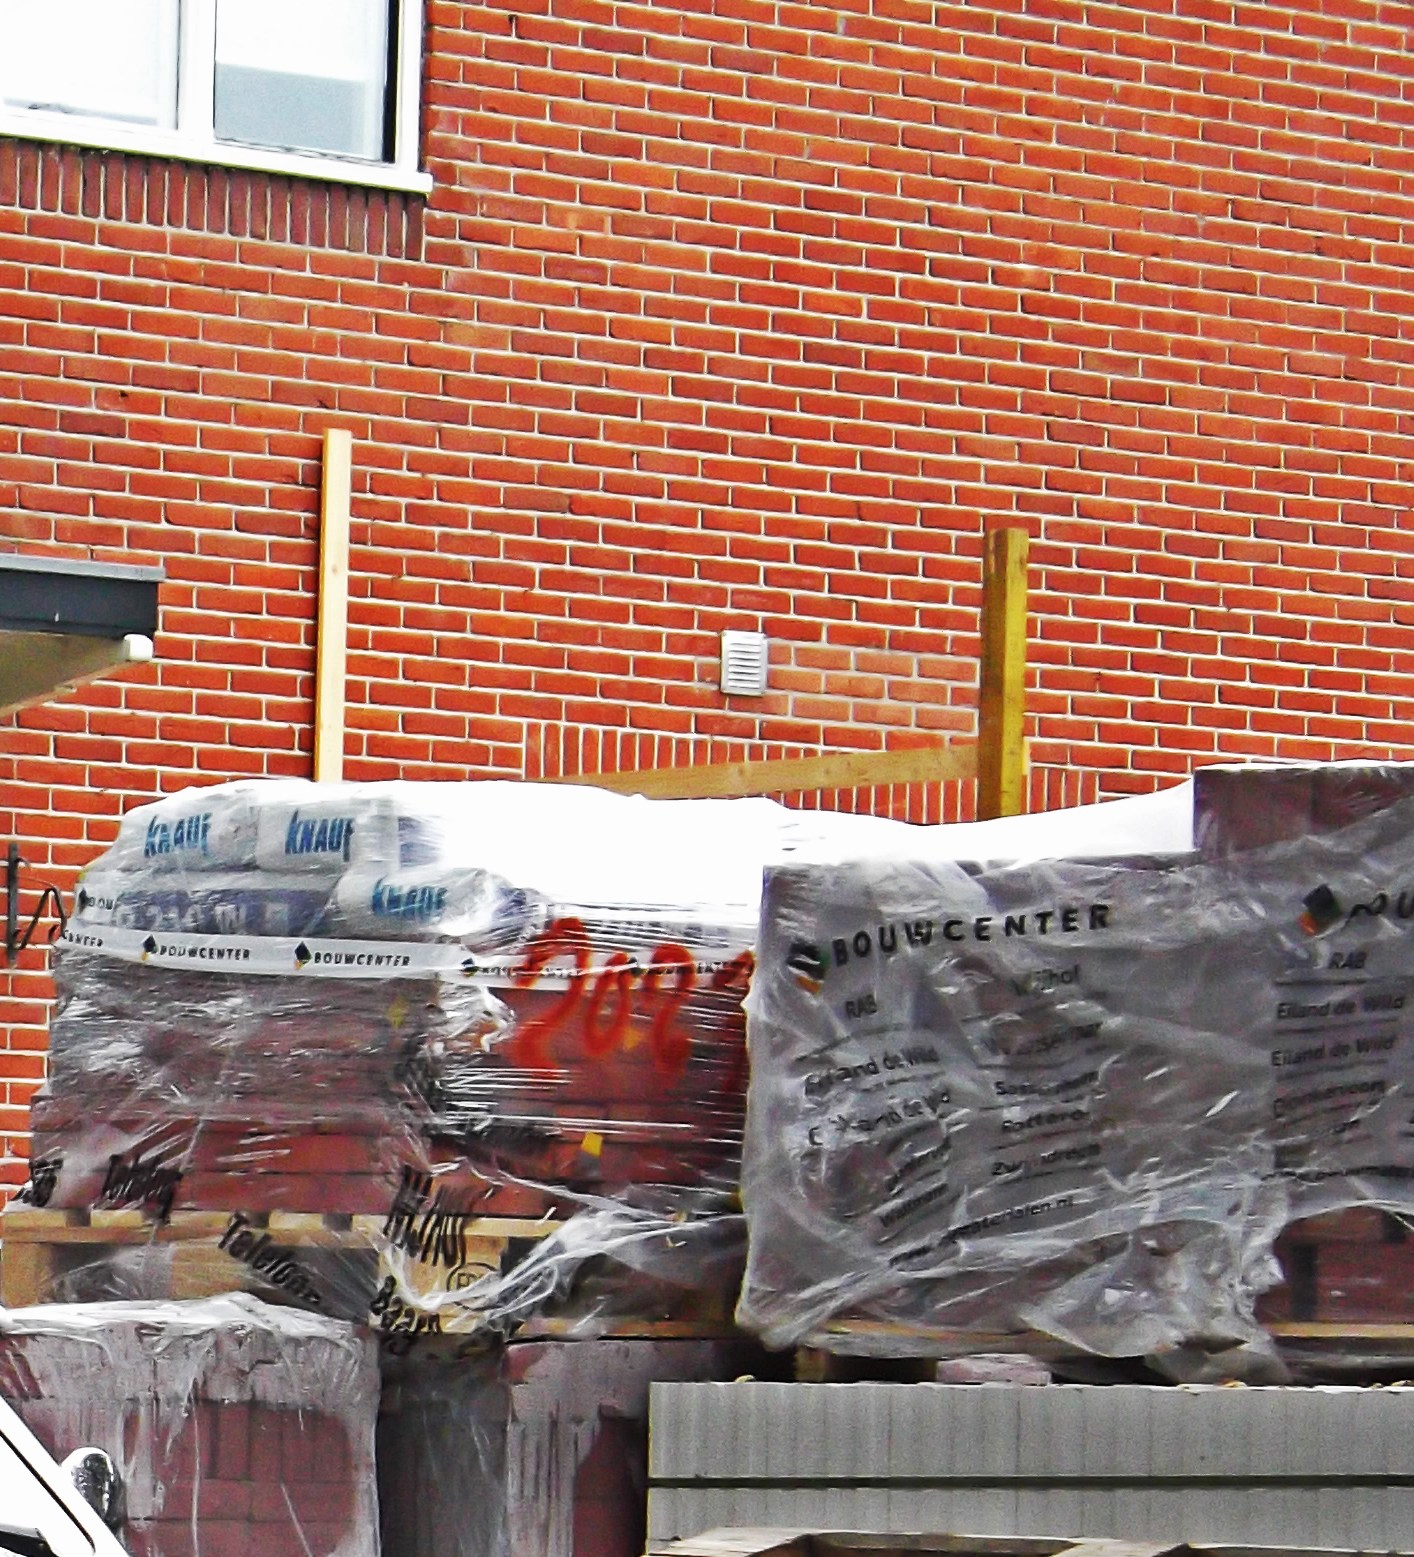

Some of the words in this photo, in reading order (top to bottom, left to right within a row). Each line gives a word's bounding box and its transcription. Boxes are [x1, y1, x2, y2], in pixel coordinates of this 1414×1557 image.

[285, 809, 355, 862] KNAUF
[160, 944, 250, 961] BOUWCENTER
[832, 904, 1110, 967] BOUWCENTER
[314, 951, 410, 967] BOUWCENTER
